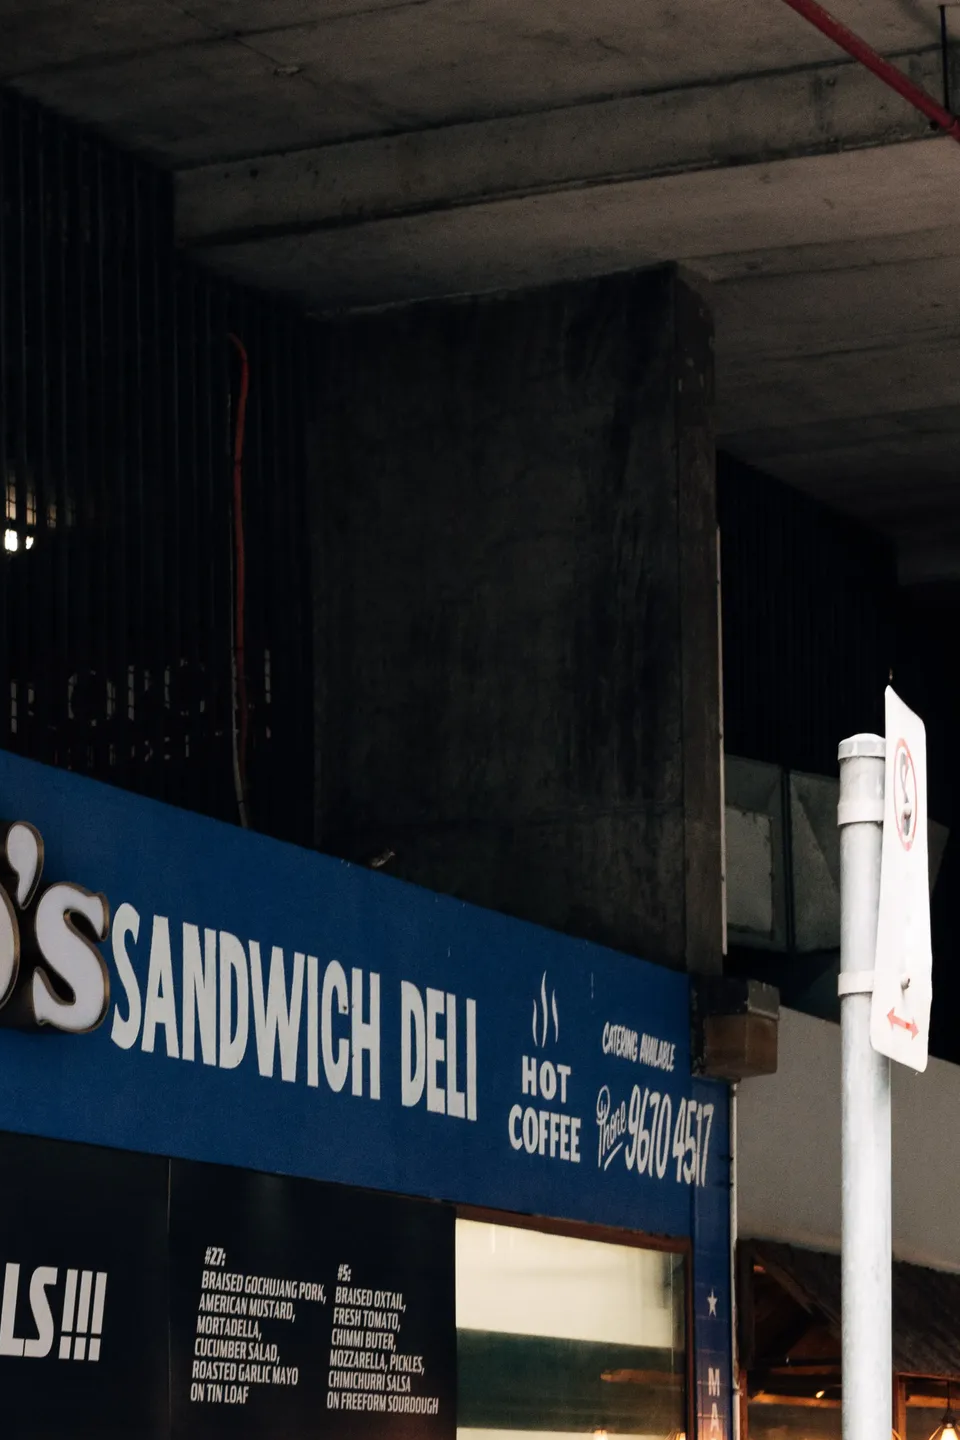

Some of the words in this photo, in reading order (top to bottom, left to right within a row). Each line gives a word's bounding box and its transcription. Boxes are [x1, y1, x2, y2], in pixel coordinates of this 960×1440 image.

[110, 903, 381, 1100] SANDWICH
[401, 980, 477, 1122] DELI
[602, 1021, 638, 1063] CATERING
[640, 1033, 676, 1072] AVAILABLE
[522, 1055, 571, 1103] HOT
[507, 1104, 581, 1163] COFFEE
[625, 1084, 672, 1179] 9670
[672, 1097, 714, 1187] 4517
[205, 1247, 226, 1266] #27:
[337, 1264, 351, 1282] #5:
[201, 1270, 244, 1292] BRAISED
[244, 1276, 297, 1298] GOCHUJANG
[299, 1282, 327, 1304] PORK,
[335, 1286, 373, 1307] BRAISED
[374, 1290, 406, 1312] OXTAIL,
[198, 1293, 247, 1315] AMERICAN
[248, 1299, 295, 1323] MUSTARD,
[333, 1307, 362, 1326] FRESH
[363, 1310, 400, 1332] TOMATO,
[196, 1315, 262, 1340] MORTADELLA,
[331, 1328, 364, 1347] CHIMMI
[365, 1331, 396, 1352] BUTER,
[194, 1338, 247, 1359] CUCUMBER
[248, 1343, 280, 1364] SALAD,
[329, 1349, 388, 1372] MOZZARELLA,
[390, 1354, 425, 1375] PICKLES,
[192, 1360, 237, 1381] ROASTED
[238, 1364, 271, 1383] GARLIC
[272, 1366, 298, 1385] MAYO
[328, 1370, 385, 1391] CHIMICHURRI
[386, 1375, 410, 1393] SALSA
[190, 1383, 205, 1402] ON
[207, 1385, 222, 1403] TIN
[224, 1386, 249, 1404] LOAF
[326, 1391, 339, 1409] ON
[340, 1392, 386, 1412] FREEFORM
[387, 1396, 439, 1415] SOURDOUGH
